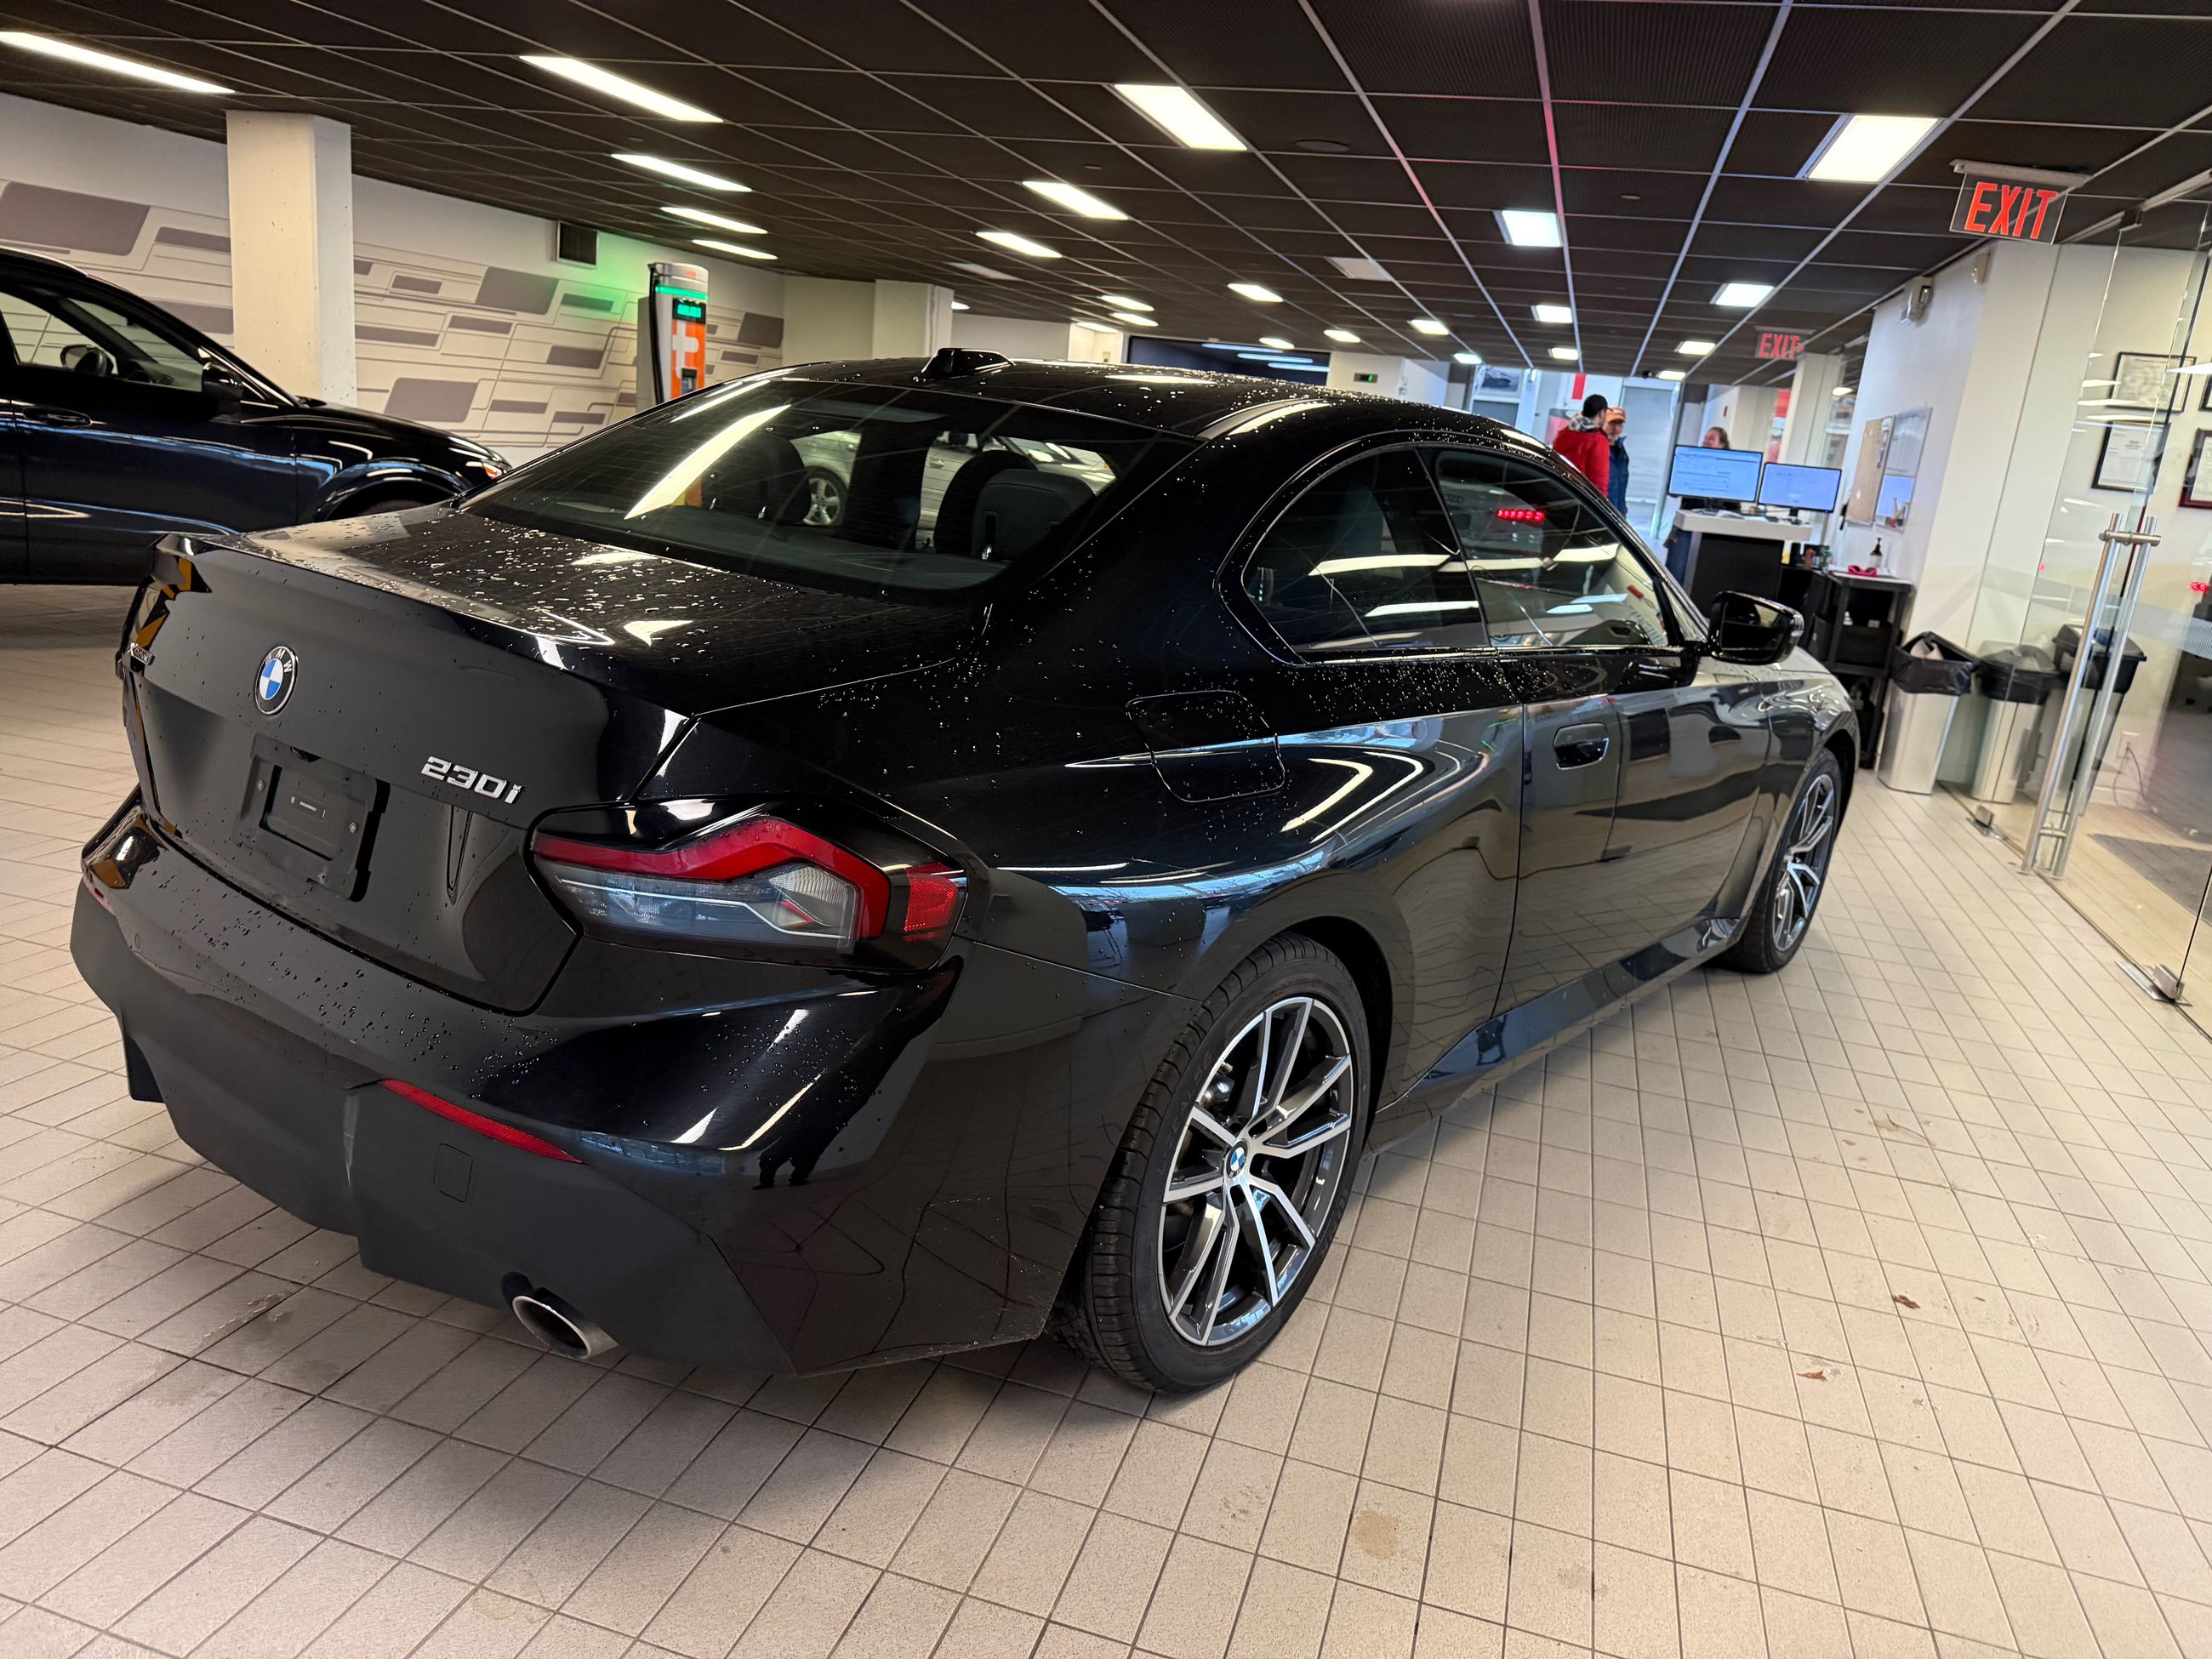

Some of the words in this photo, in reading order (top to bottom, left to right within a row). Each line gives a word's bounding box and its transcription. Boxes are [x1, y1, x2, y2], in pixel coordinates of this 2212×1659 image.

[1964, 181, 2058, 239] EXIT
[1759, 333, 1800, 360] EXIT
[421, 756, 522, 804] 230i
